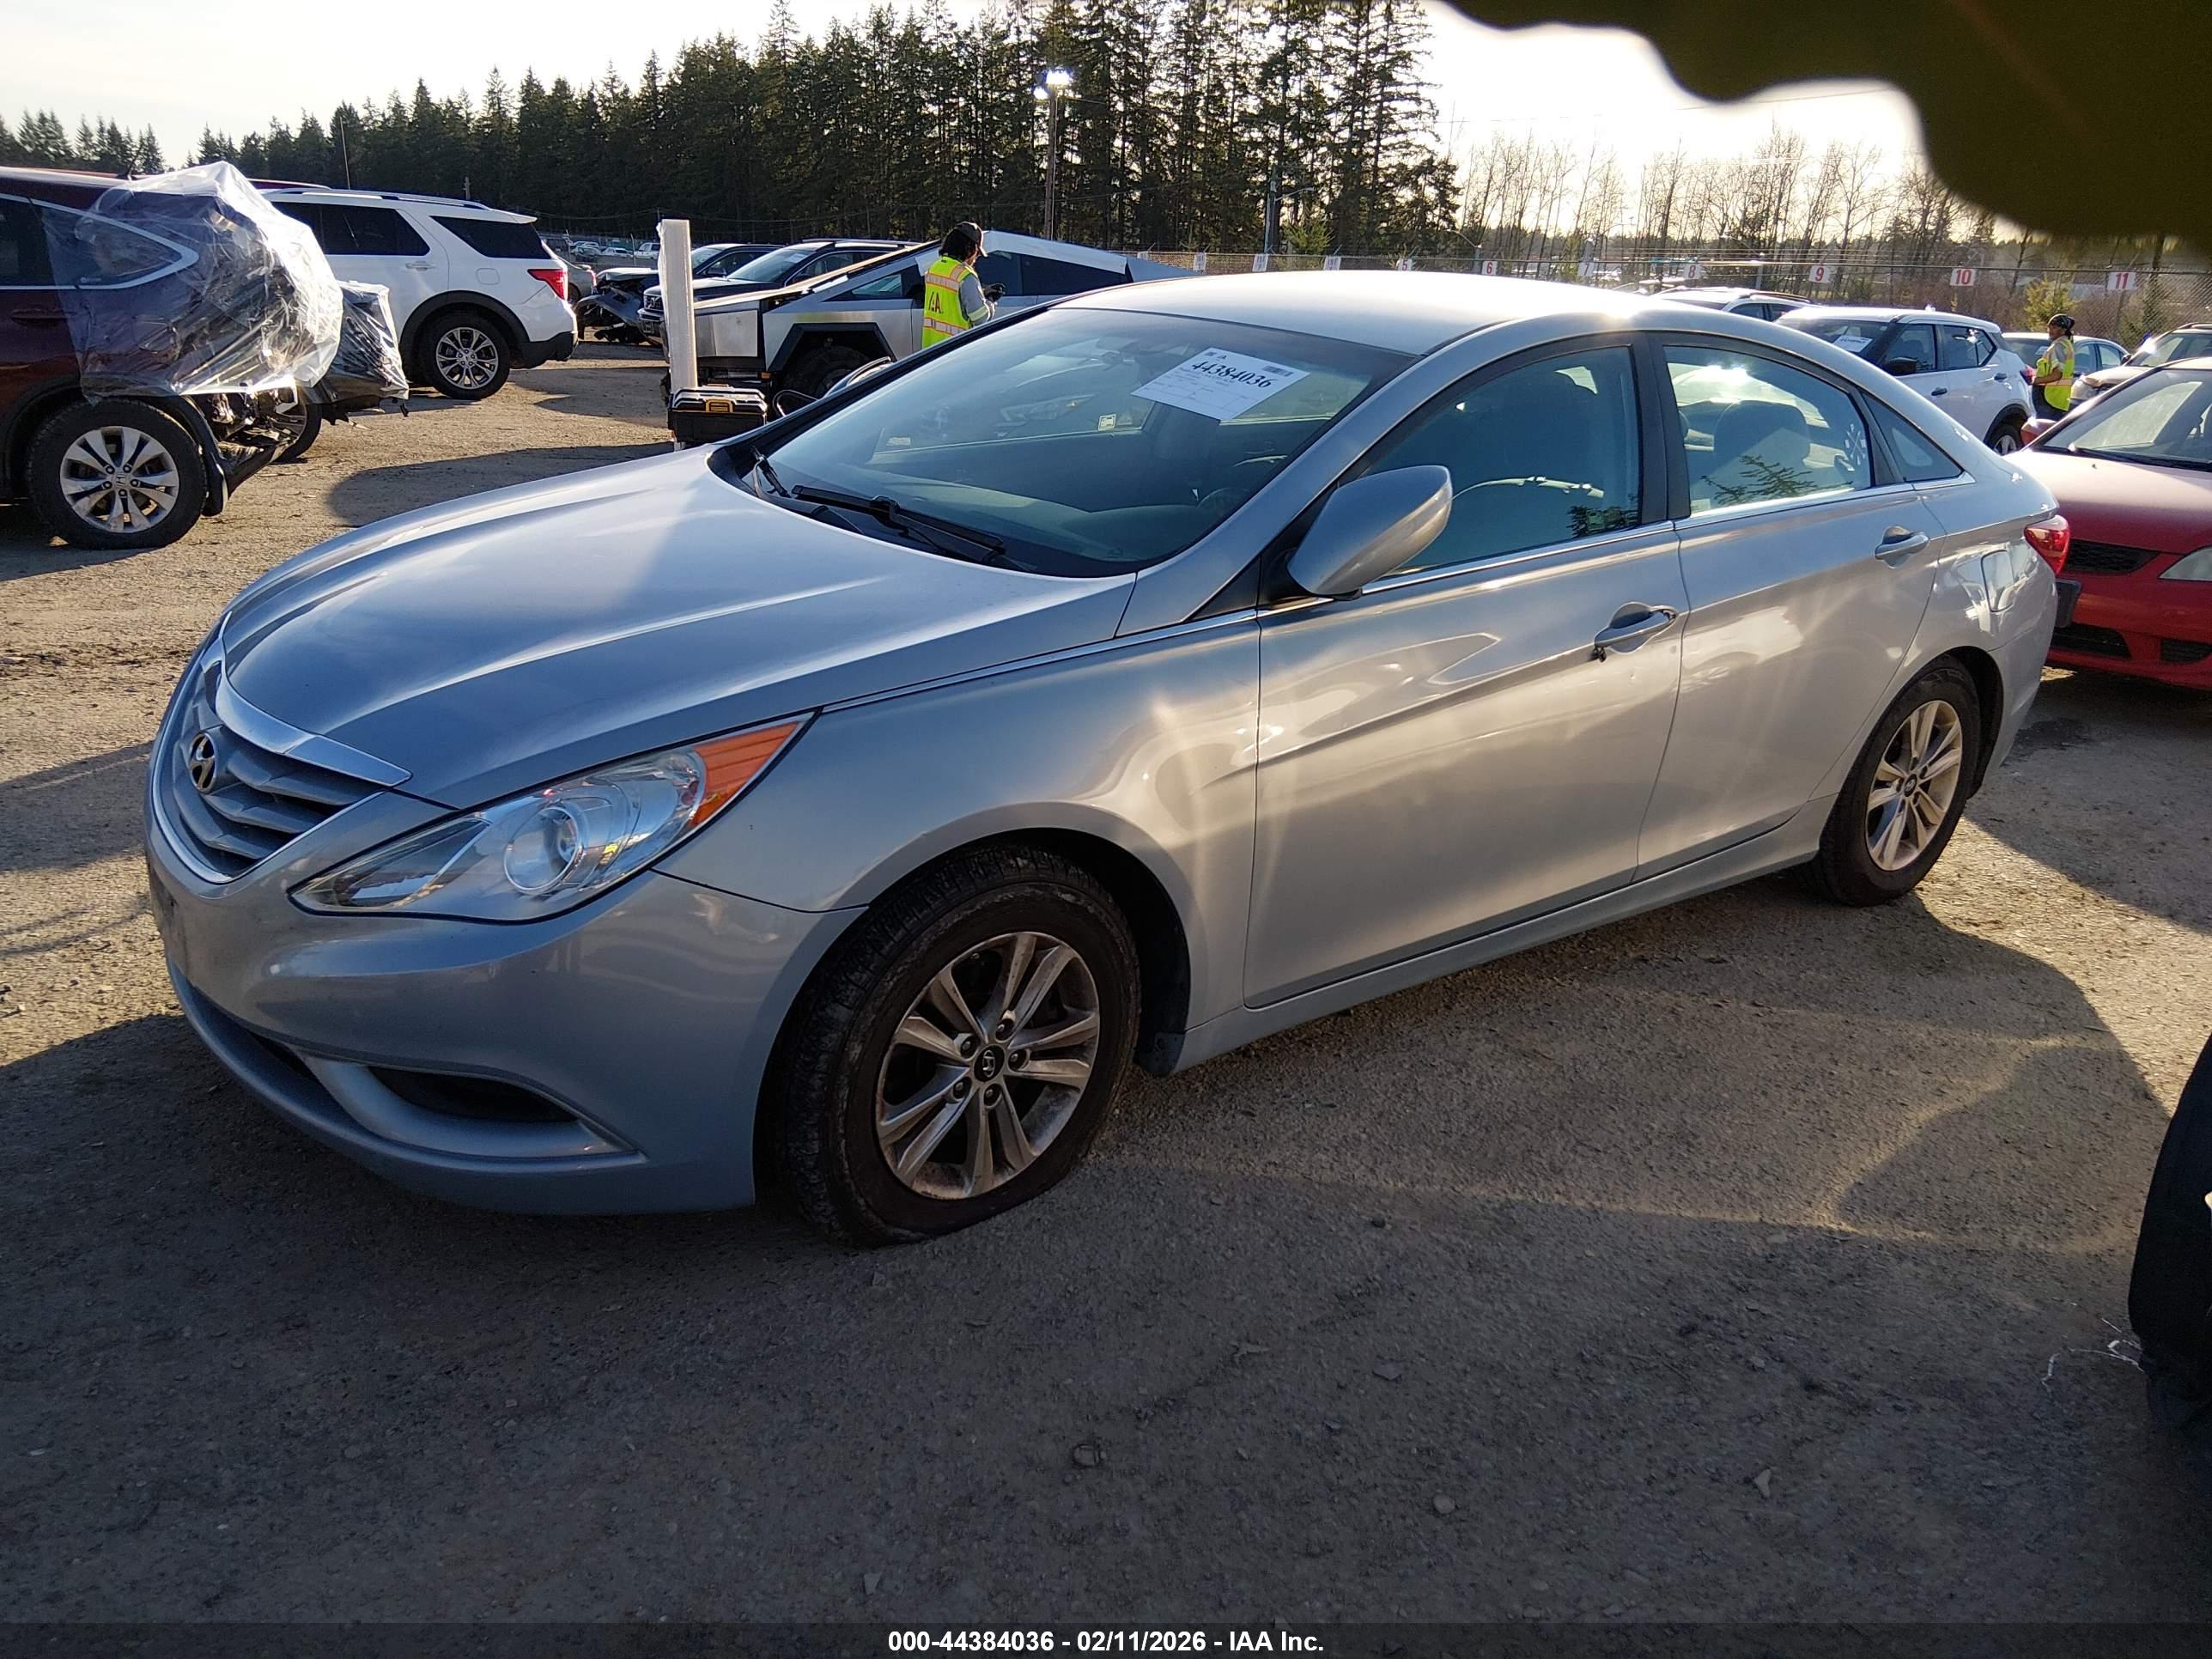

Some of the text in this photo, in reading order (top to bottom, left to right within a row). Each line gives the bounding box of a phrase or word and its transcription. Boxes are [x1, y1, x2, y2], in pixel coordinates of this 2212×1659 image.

[1401, 259, 1408, 271] 5
[1486, 261, 1493, 275] 6
[1687, 265, 1697, 279] 8
[1814, 267, 1825, 282] 9
[1955, 270, 1972, 285] 10
[2115, 273, 2130, 289] 11
[1191, 361, 1278, 388] 44384036
